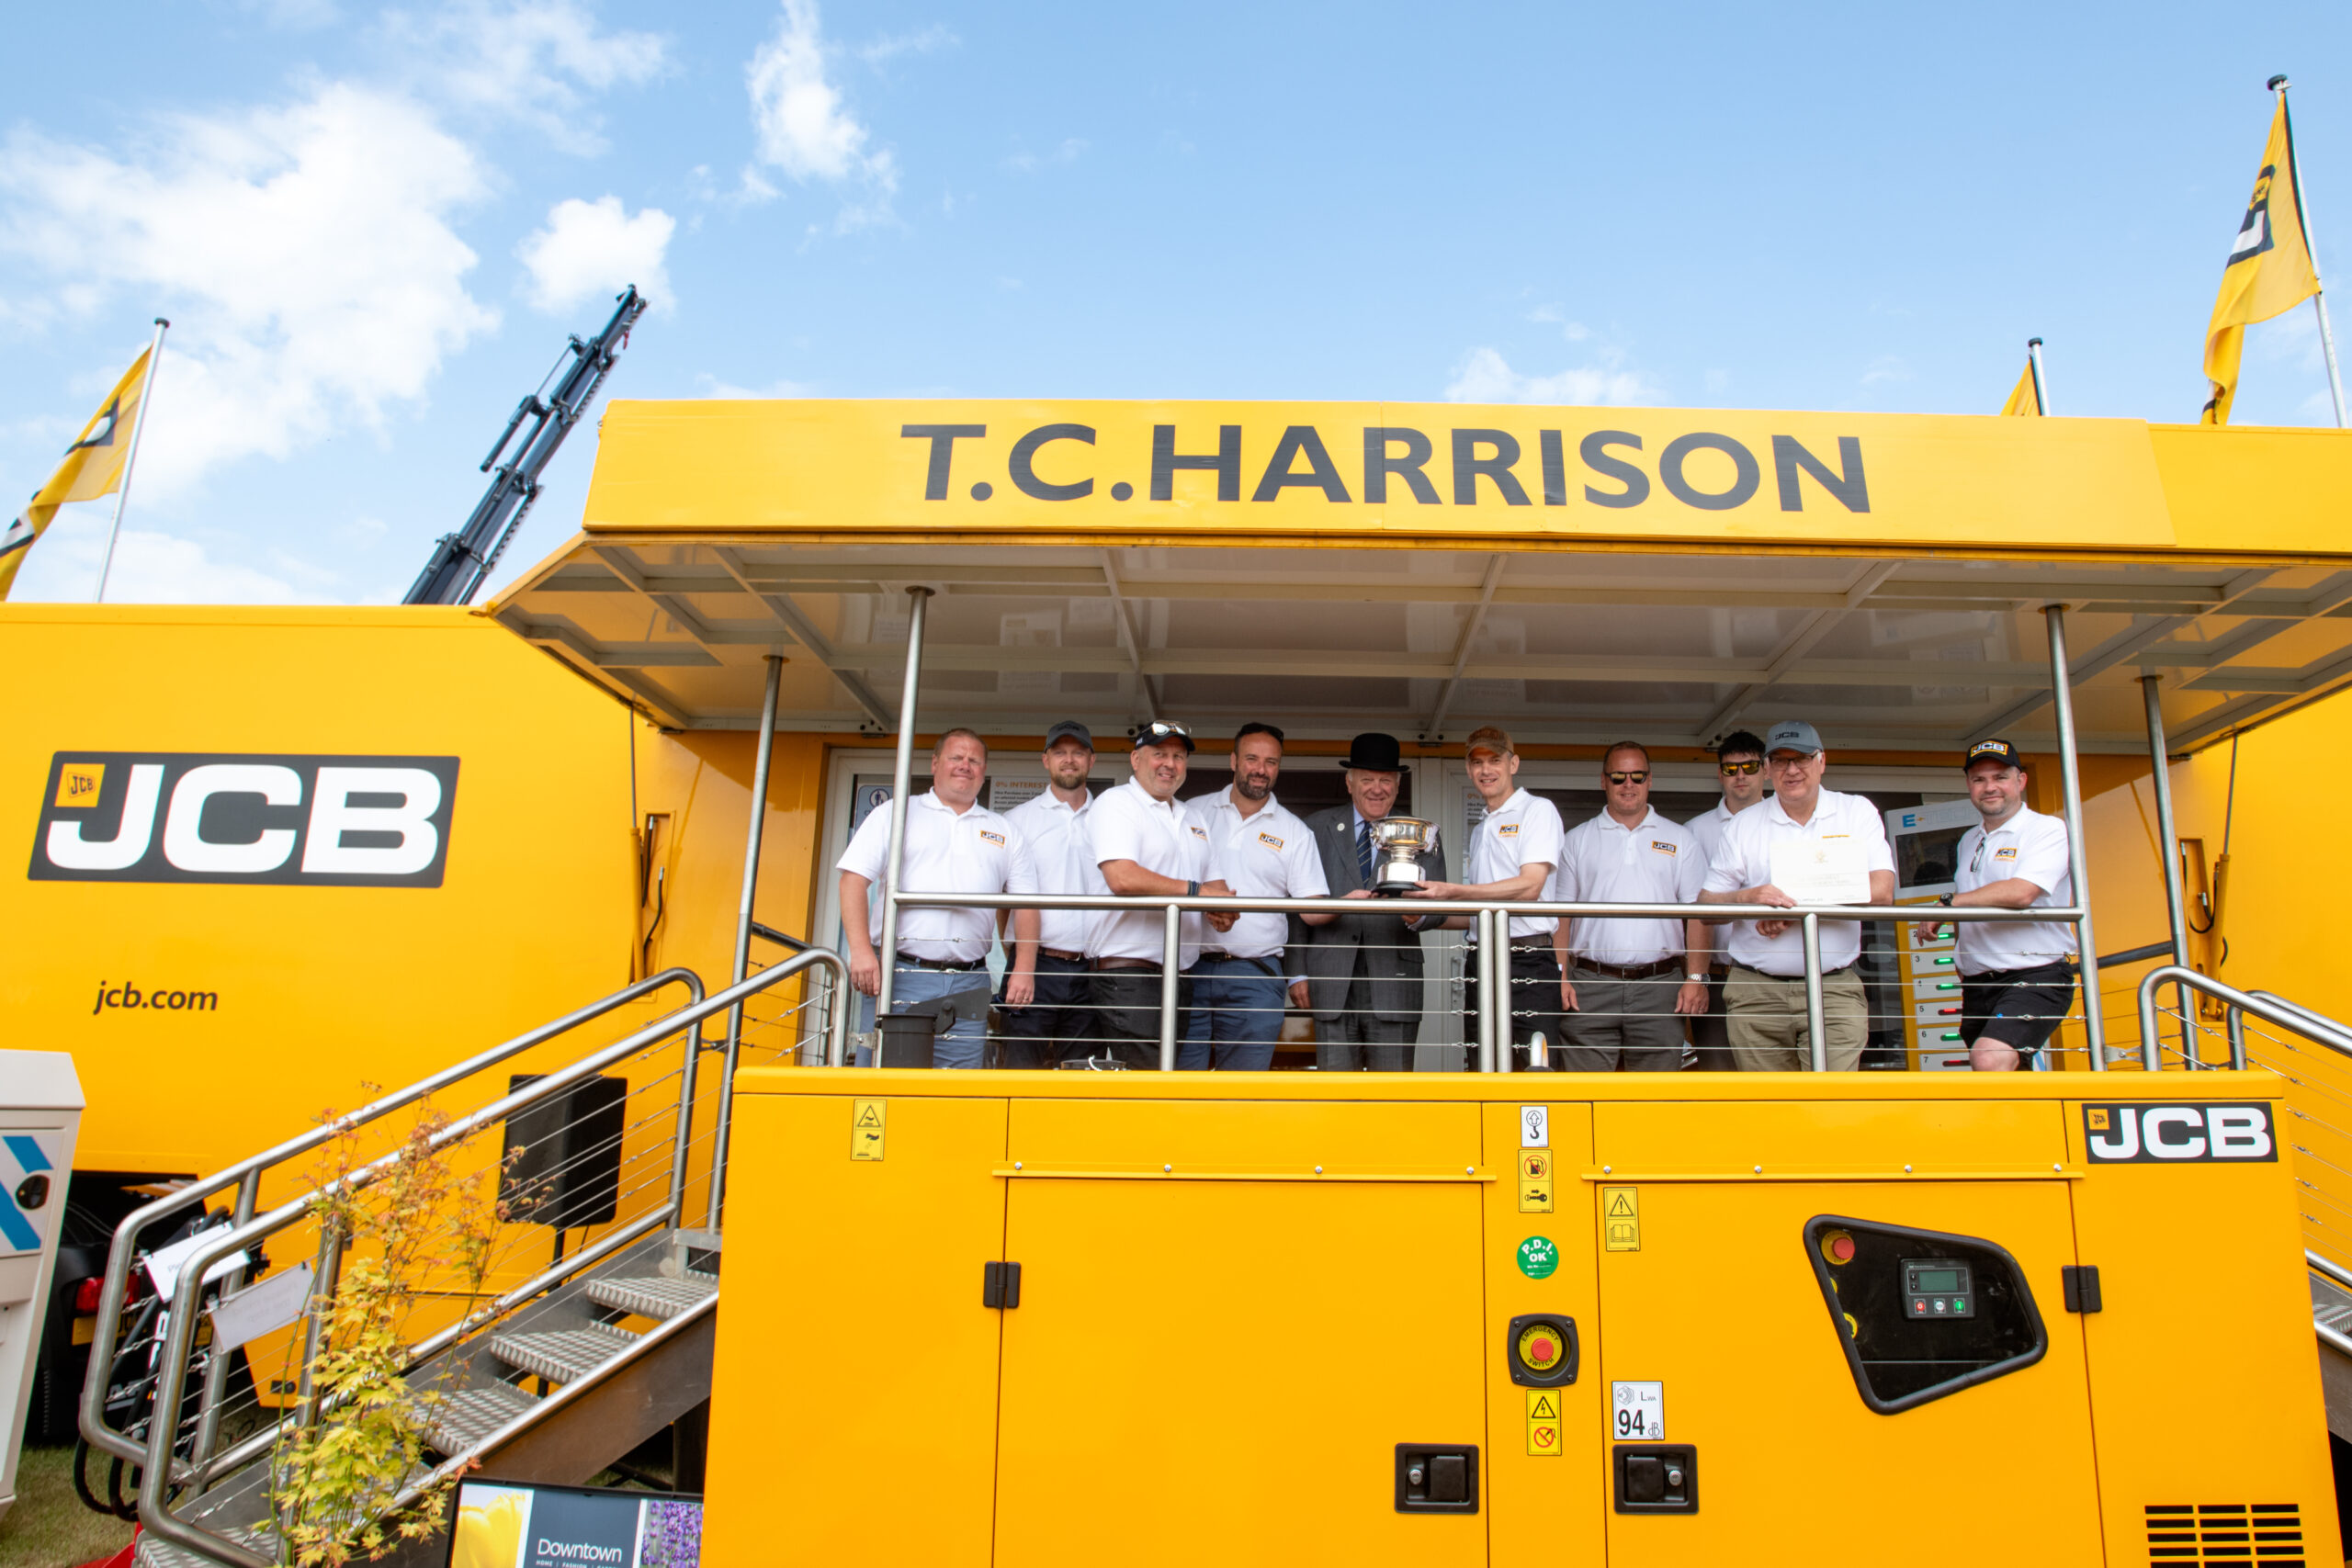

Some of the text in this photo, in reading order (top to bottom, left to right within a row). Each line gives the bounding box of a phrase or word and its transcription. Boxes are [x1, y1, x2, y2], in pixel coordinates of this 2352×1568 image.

[900, 423, 1871, 513] T.C.HARRISON
[1775, 731, 1800, 740] JCB
[1973, 742, 2005, 753] JCB
[71, 775, 94, 795] JCB
[46, 763, 443, 875] JCB
[982, 831, 1004, 844] JCB
[1260, 834, 1282, 848] JCB
[1654, 841, 1675, 852] JCB
[93, 980, 219, 1015] jcb.com
[2089, 1107, 2272, 1159] JCB
[1521, 1239, 1553, 1255] P.D.I.
[1529, 1252, 1547, 1262] OK
[1521, 1325, 1559, 1342] EMERGENCY
[1527, 1358, 1555, 1368] SWITCH
[1618, 1408, 1661, 1437] 94 dB
[537, 1538, 623, 1563] Downtown
